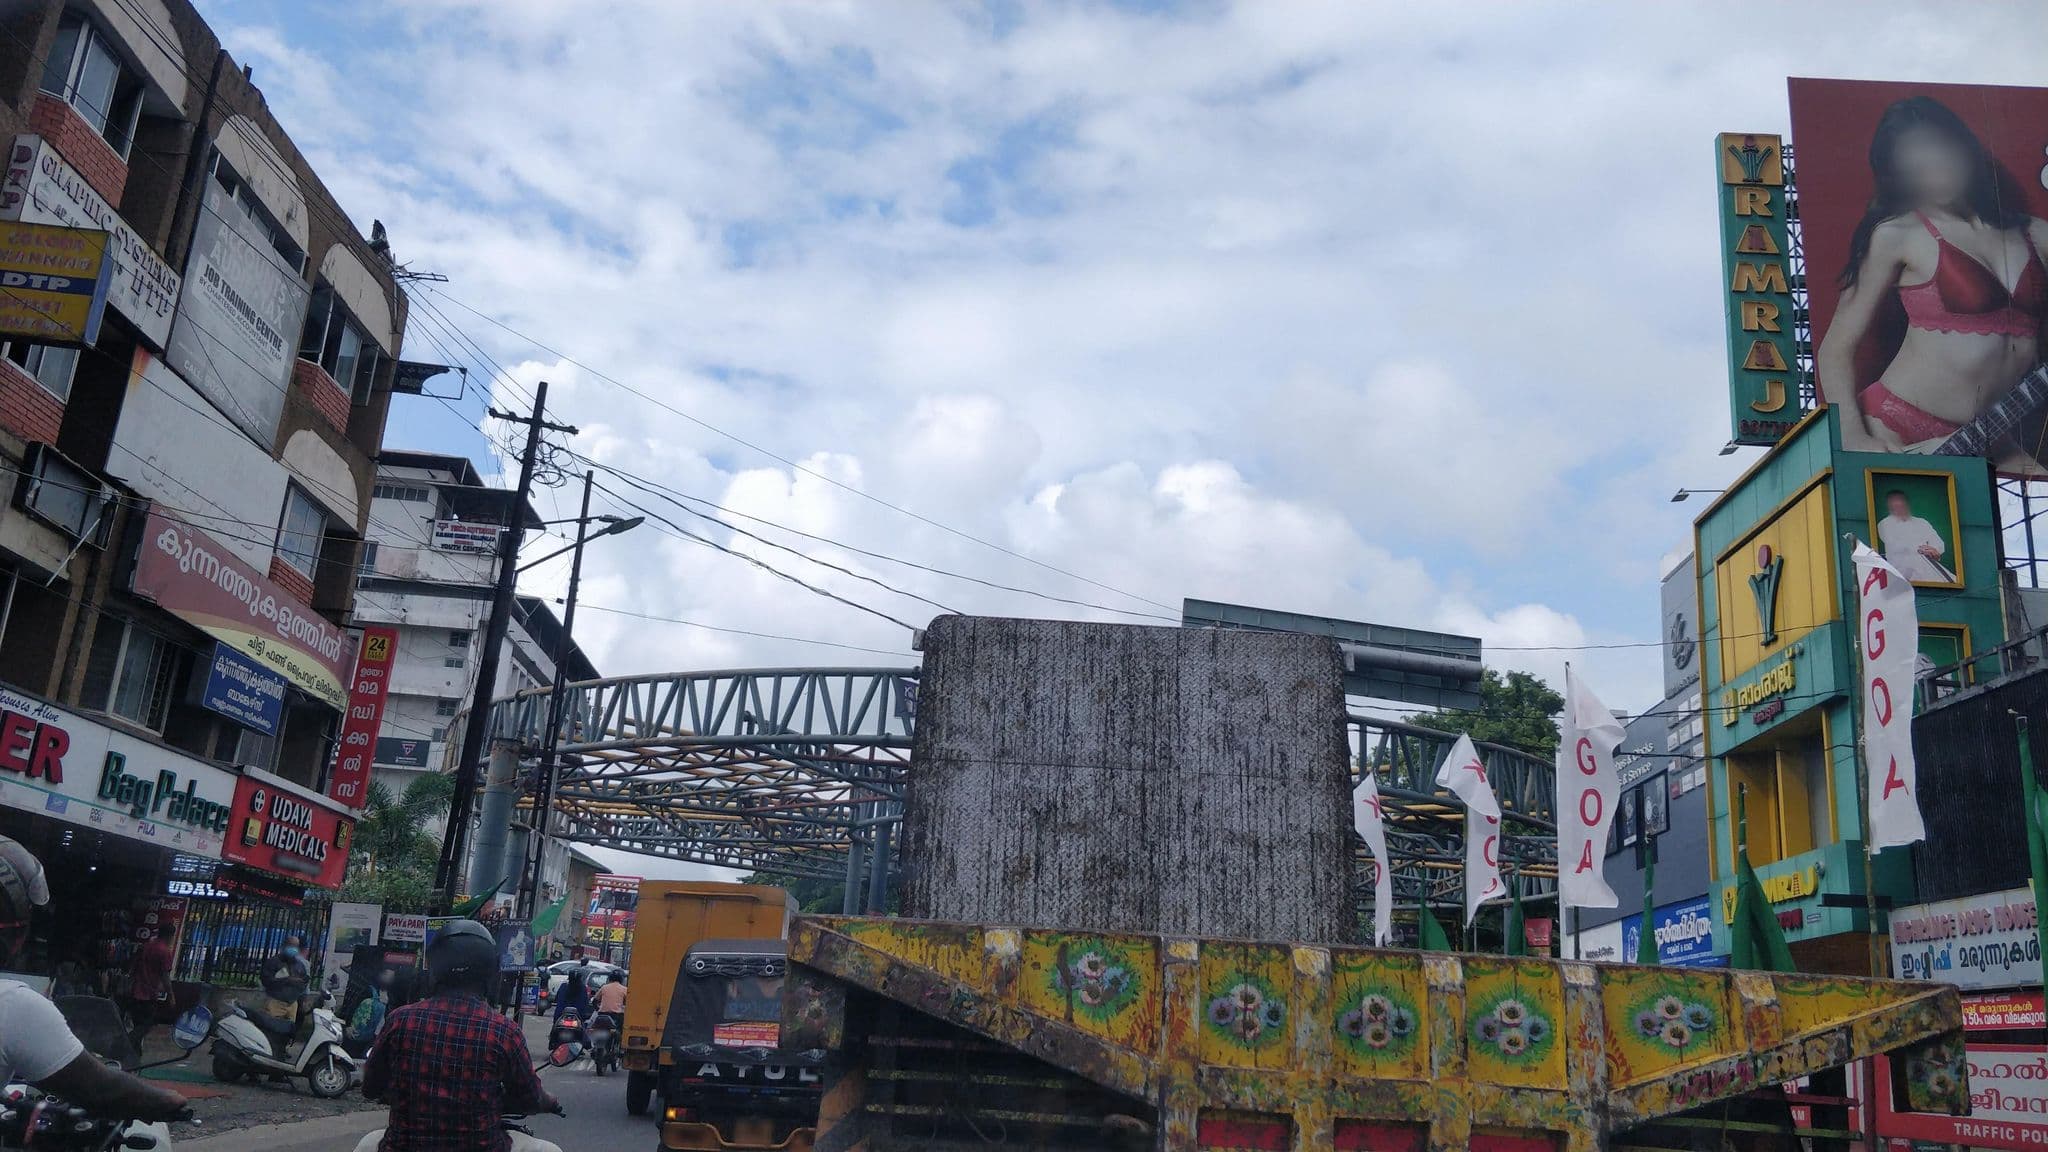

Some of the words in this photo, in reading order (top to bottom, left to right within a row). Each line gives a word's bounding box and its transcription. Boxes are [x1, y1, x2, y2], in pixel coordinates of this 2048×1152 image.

[2, 271, 71, 291] DTP
[203, 263, 220, 289] JOB
[220, 277, 256, 326] TRAINING
[255, 317, 283, 353] CENTRE
[157, 527, 342, 663] കുന്നത്തുകളത്തിൽ
[369, 637, 387, 652] 24
[98, 750, 154, 818] Bag
[153, 769, 231, 833] Palace
[1575, 736, 1603, 874] GOA
[137, 820, 156, 836] FILA
[271, 795, 313, 831] UDAYA
[265, 822, 329, 861] MEDICALS
[388, 917, 402, 928] PAY
[1959, 932, 2041, 973] മരുന്നുകൾ
[1954, 1122, 2015, 1141] TRAFFIC
